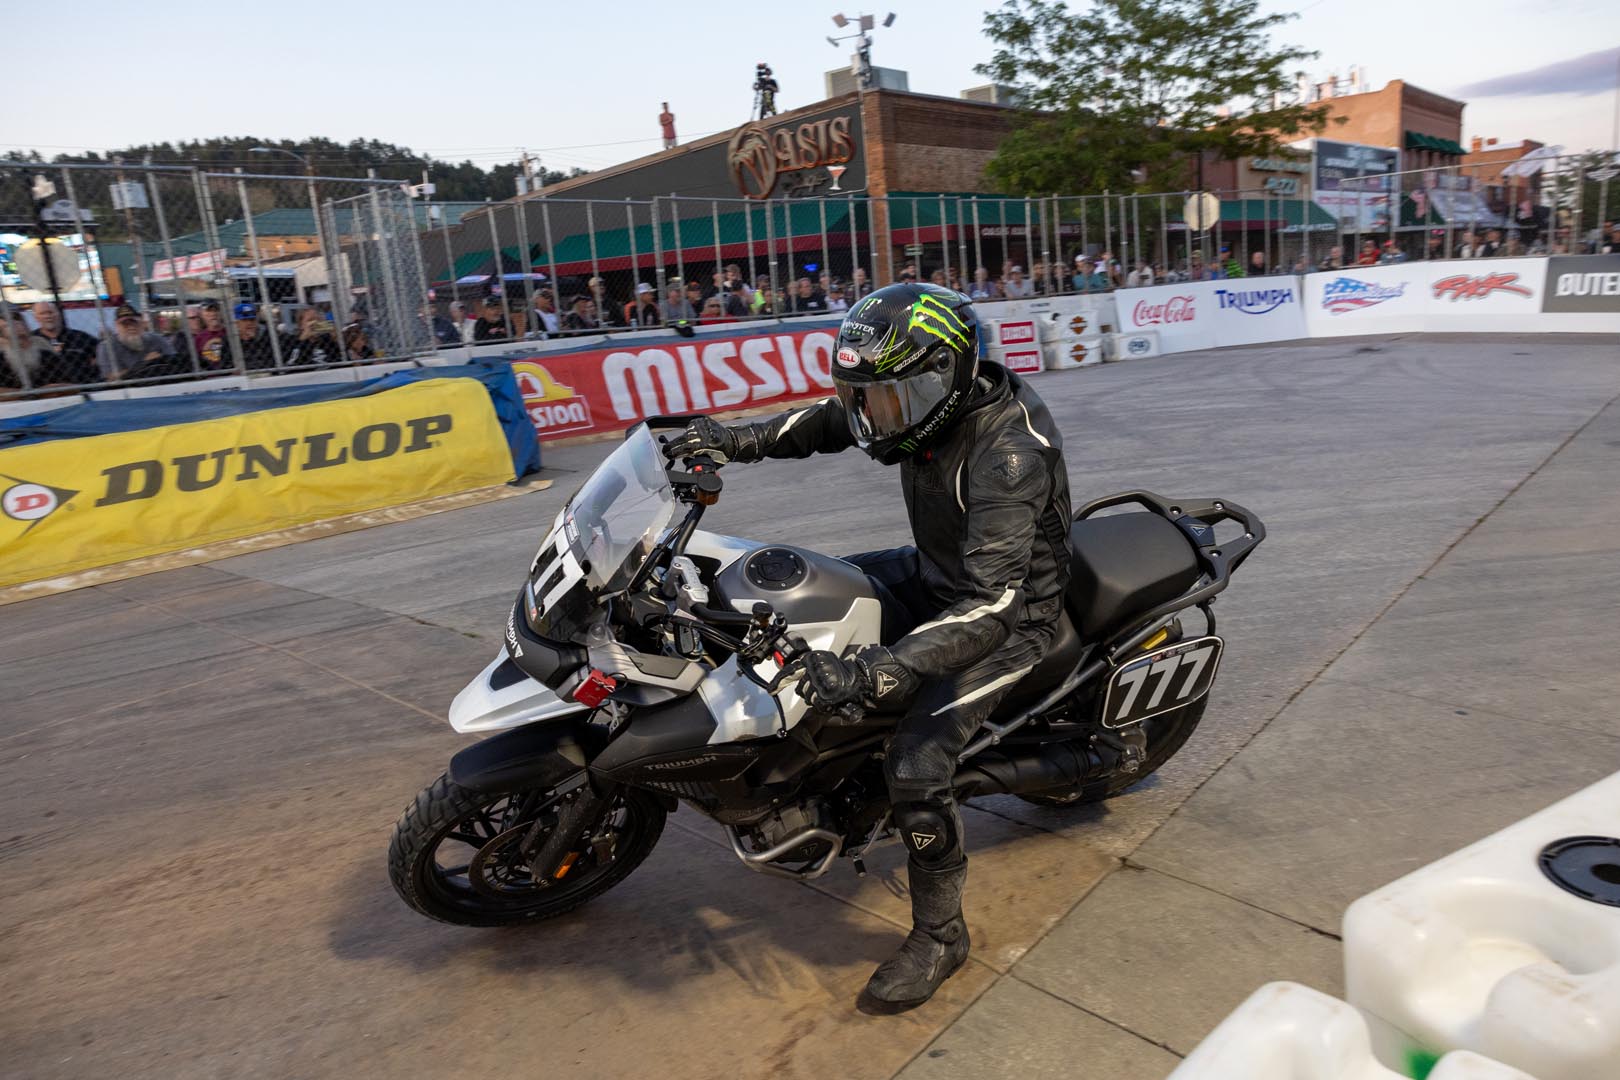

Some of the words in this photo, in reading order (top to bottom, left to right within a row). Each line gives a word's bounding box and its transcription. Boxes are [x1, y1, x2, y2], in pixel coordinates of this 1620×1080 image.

[728, 116, 857, 200] OASIS
[1215, 289, 1294, 315] TRIUMPH
[602, 332, 835, 421] MISSIO
[839, 351, 856, 363] BELL
[916, 390, 960, 440] MONSTER
[95, 413, 453, 508] DUNLOP
[14, 493, 50, 513] D
[1115, 645, 1214, 720] 777
[643, 755, 717, 770] TRIUMPH
